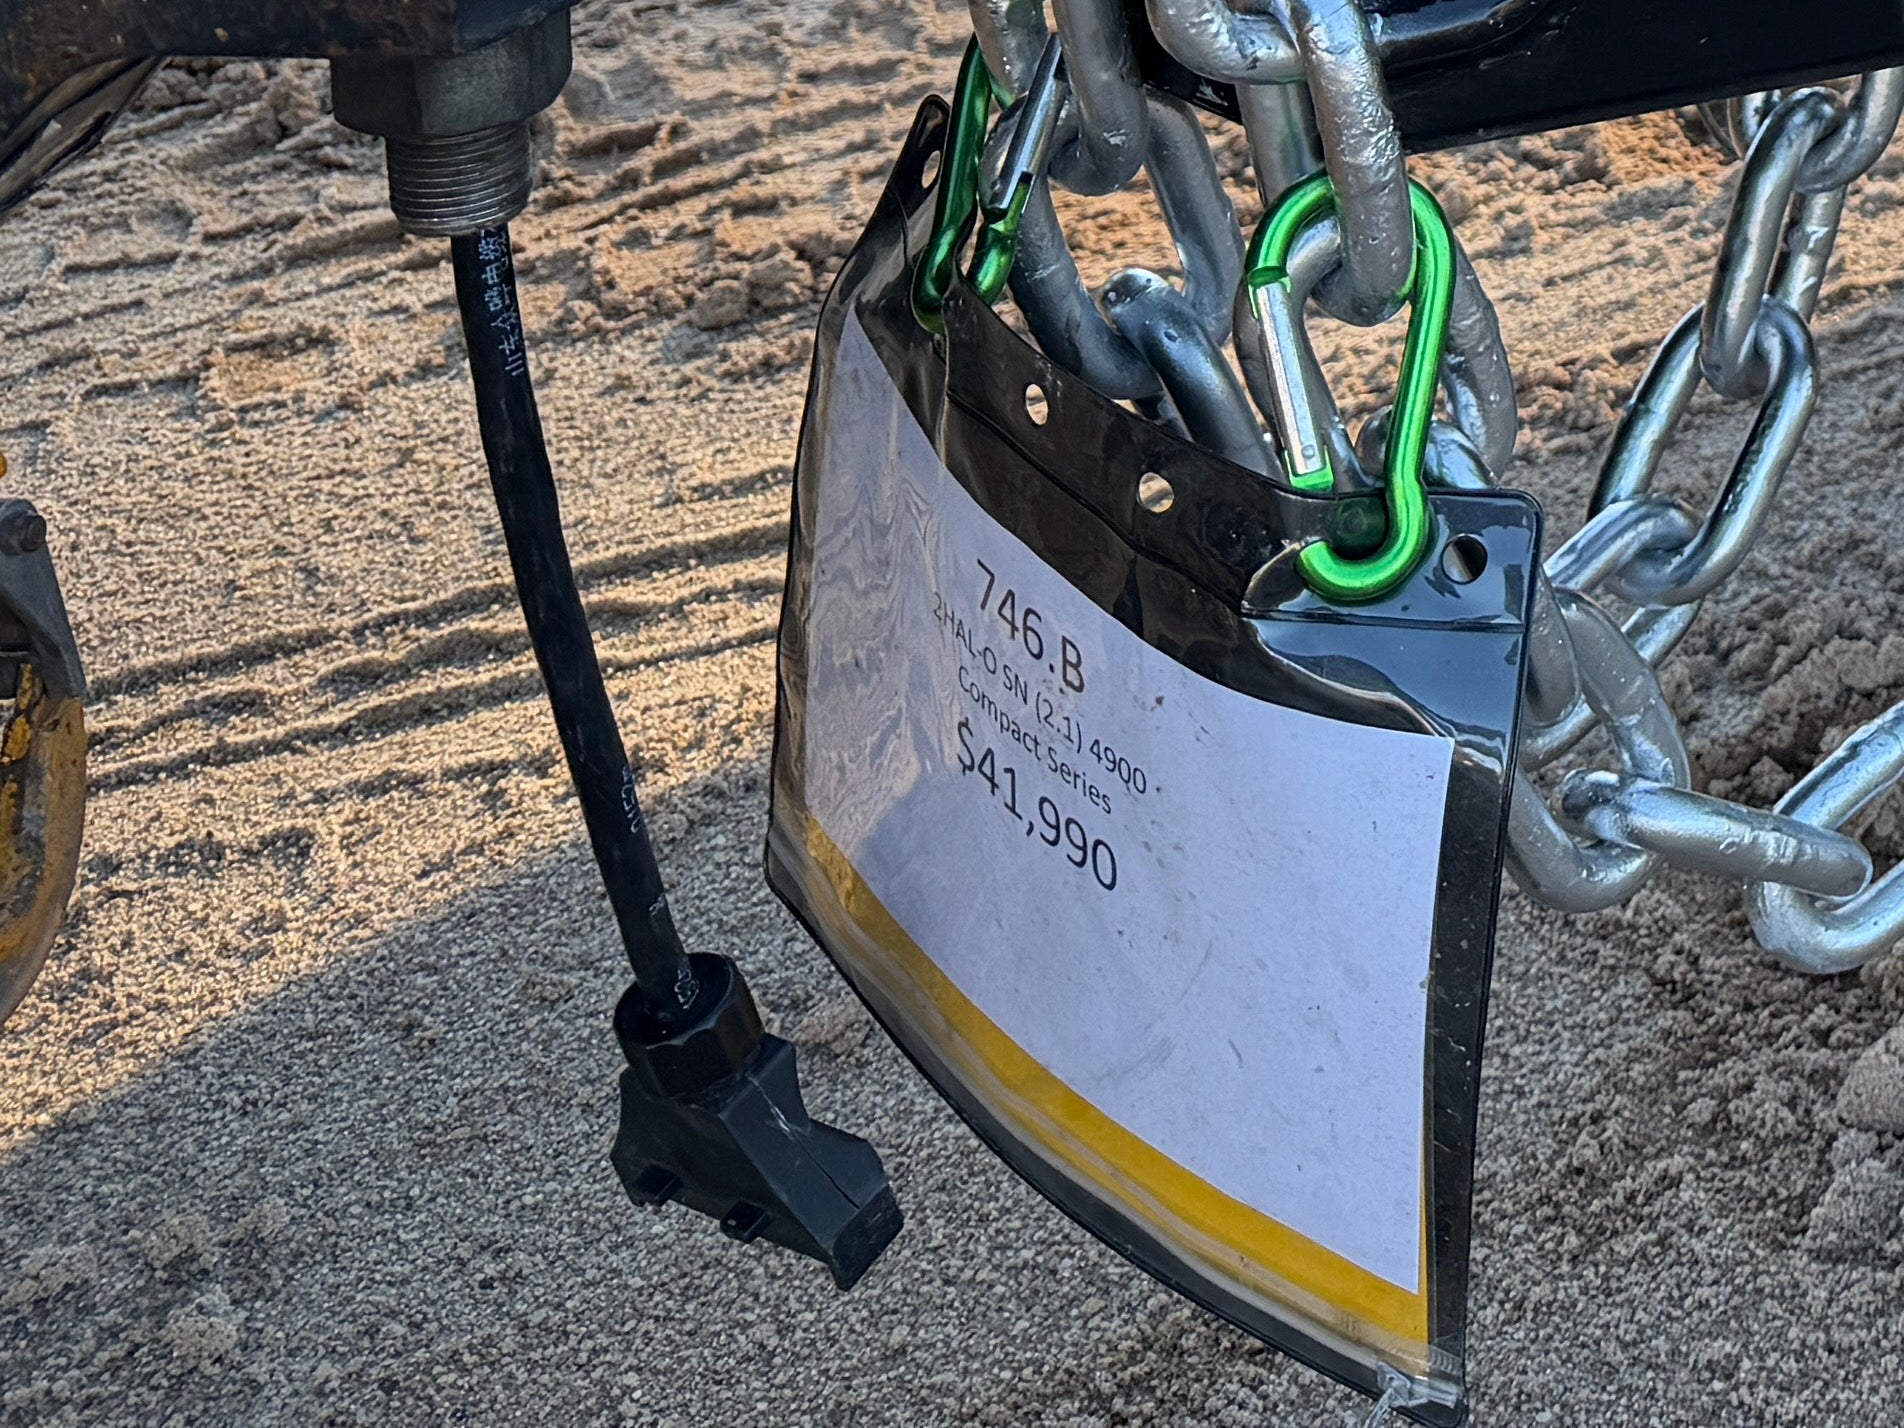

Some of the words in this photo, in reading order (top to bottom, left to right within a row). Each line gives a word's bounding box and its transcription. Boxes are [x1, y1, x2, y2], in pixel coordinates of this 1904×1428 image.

[976, 558, 1086, 694] 746.B
[957, 665, 1042, 762] Compact
[1047, 746, 1113, 815] Series
[1002, 664, 1029, 706] SN
[1035, 691, 1084, 754] (2.1)
[1089, 738, 1148, 795] 4900
[956, 716, 1119, 892] $41,990
